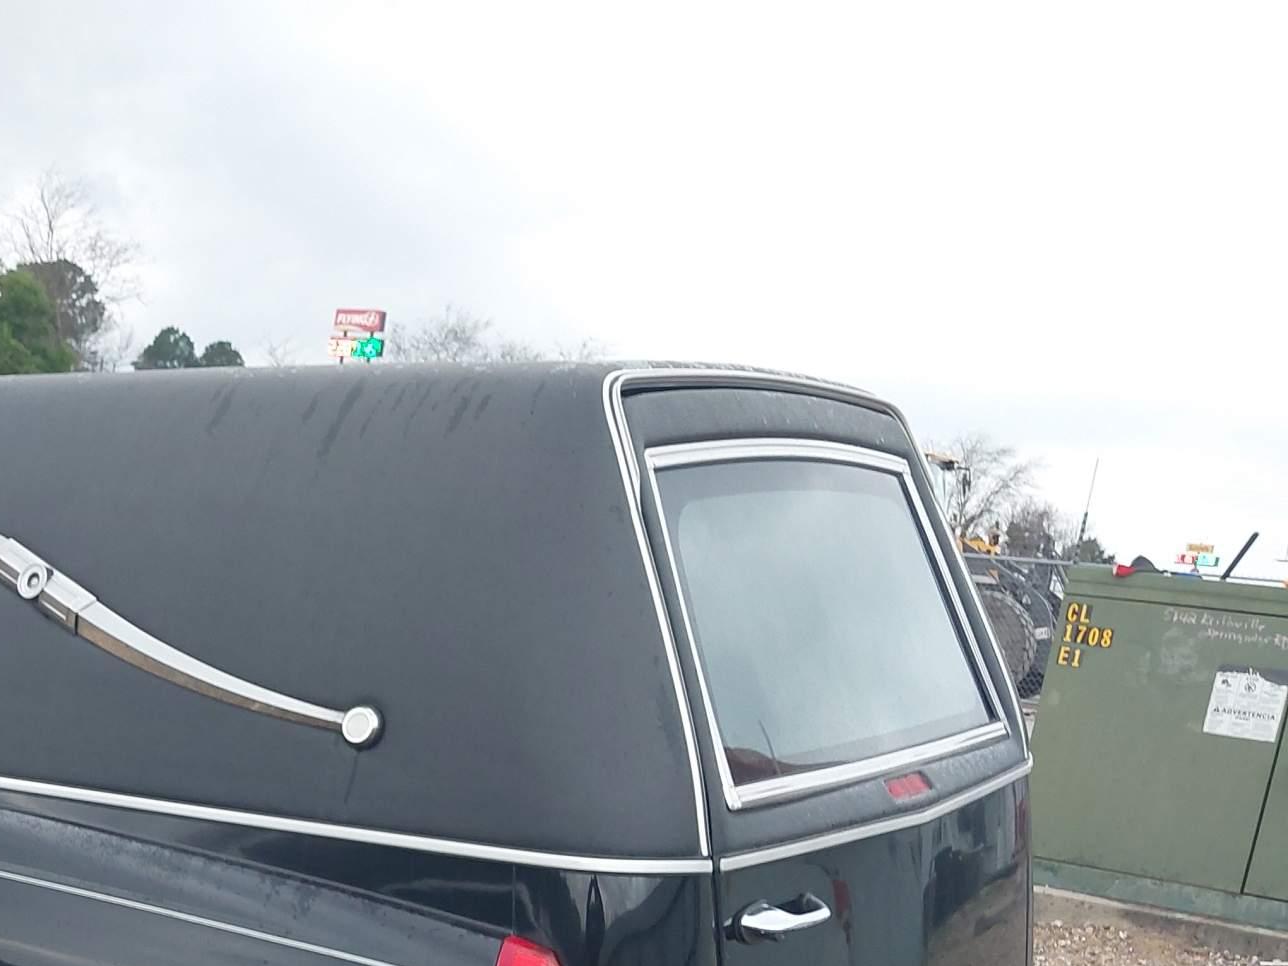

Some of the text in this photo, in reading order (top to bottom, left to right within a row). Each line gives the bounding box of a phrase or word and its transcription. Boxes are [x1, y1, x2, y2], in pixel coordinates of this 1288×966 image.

[1067, 602, 1090, 622] CL
[1063, 624, 1113, 648] 1708
[1057, 646, 1081, 667] E1
[1221, 706, 1276, 721] ADVERTENCIA
